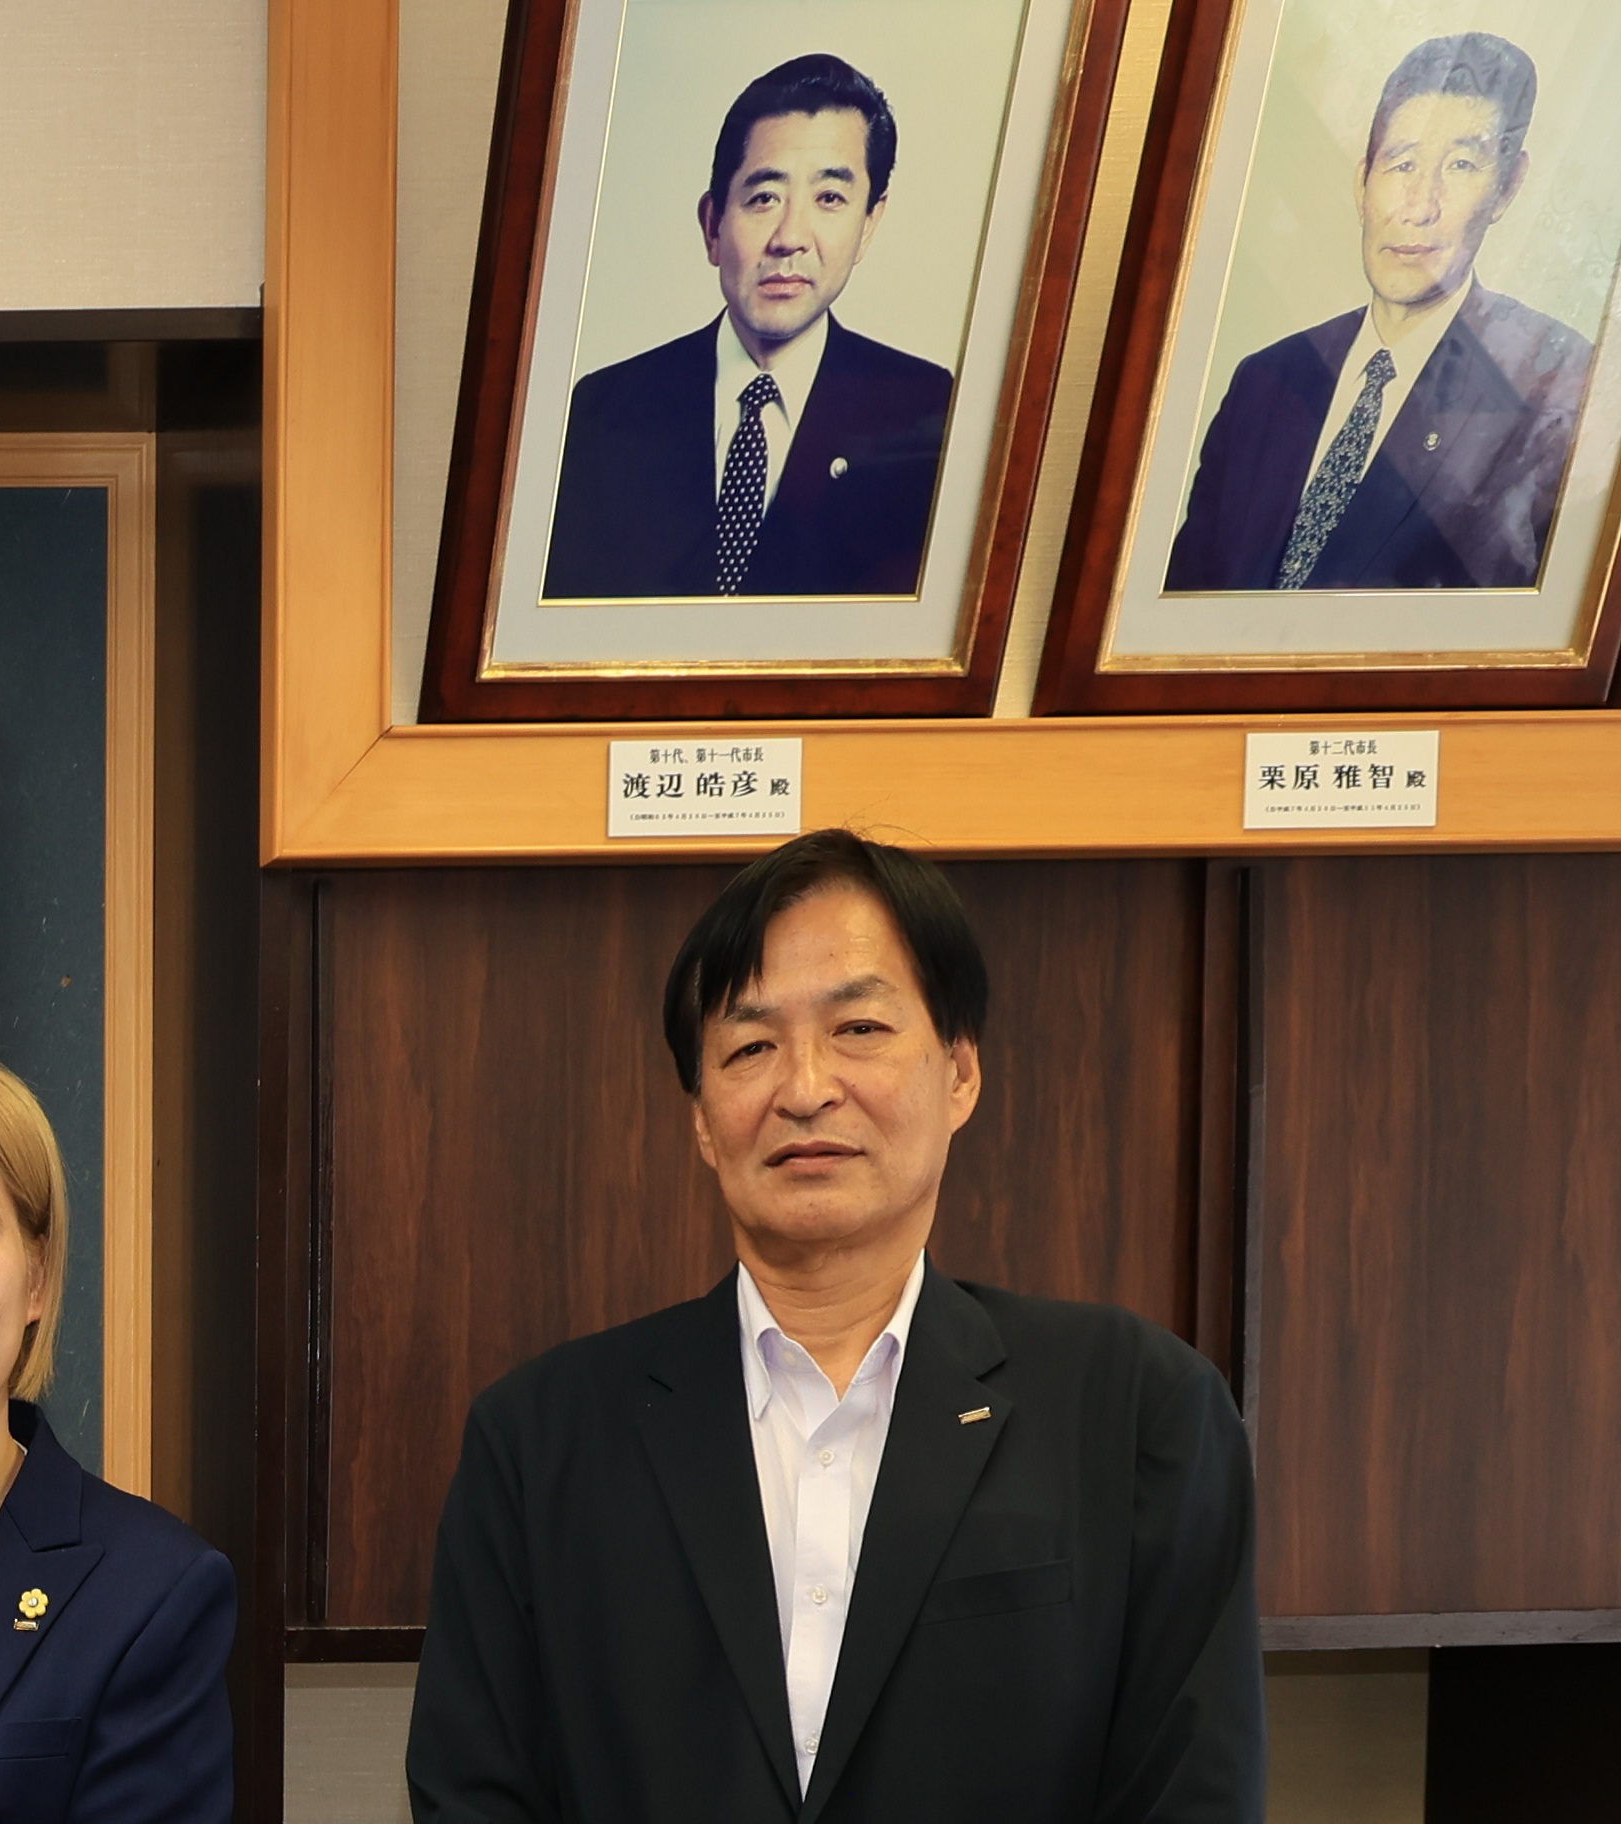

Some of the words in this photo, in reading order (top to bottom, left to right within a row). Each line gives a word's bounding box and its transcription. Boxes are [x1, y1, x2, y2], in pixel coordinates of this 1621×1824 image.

[1309, 740, 1378, 755] 第十二代市長
[622, 773, 685, 799] 渡辺
[770, 778, 790, 796] 殿
[1259, 764, 1320, 790] 栗原
[1333, 764, 1394, 789] 雅智
[1405, 770, 1427, 788] 殿
